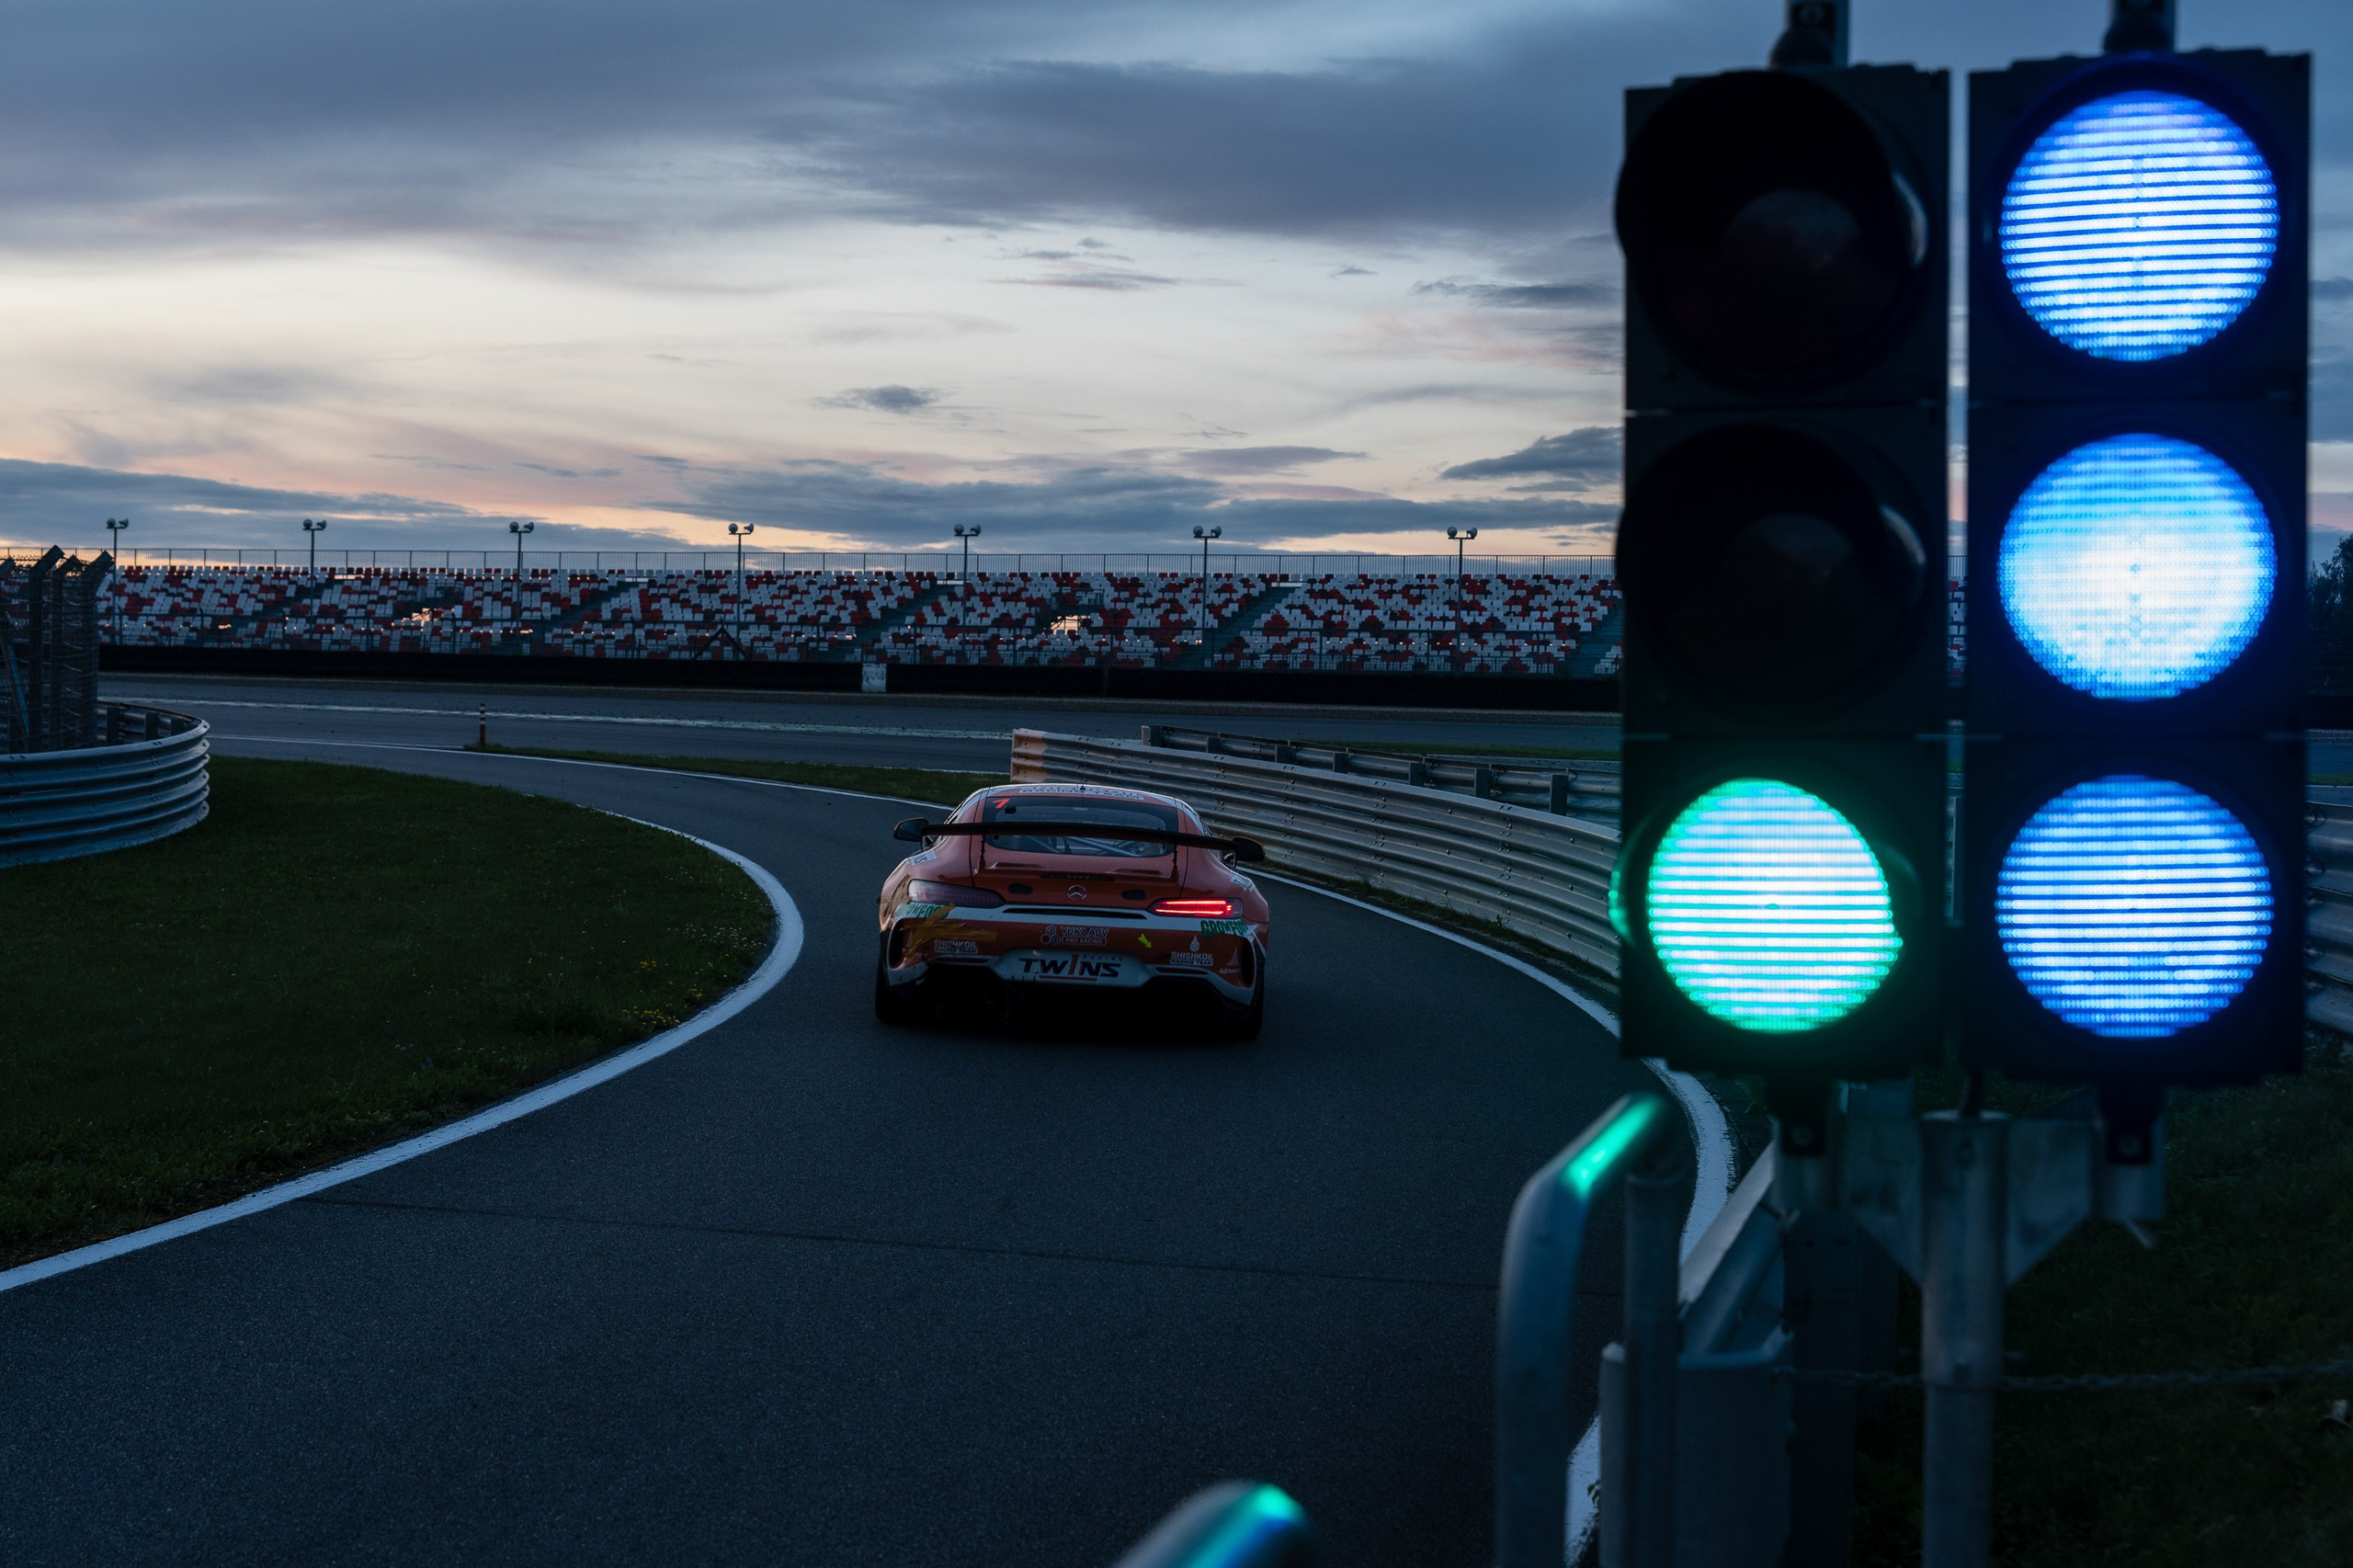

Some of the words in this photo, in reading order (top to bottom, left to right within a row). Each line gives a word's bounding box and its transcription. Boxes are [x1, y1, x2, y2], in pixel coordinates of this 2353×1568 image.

[1061, 927, 1087, 936] YUKA
[1088, 928, 1108, 937] ADV
[1171, 951, 1212, 960] SHISHKOIL
[1018, 954, 1121, 978] TWINS
